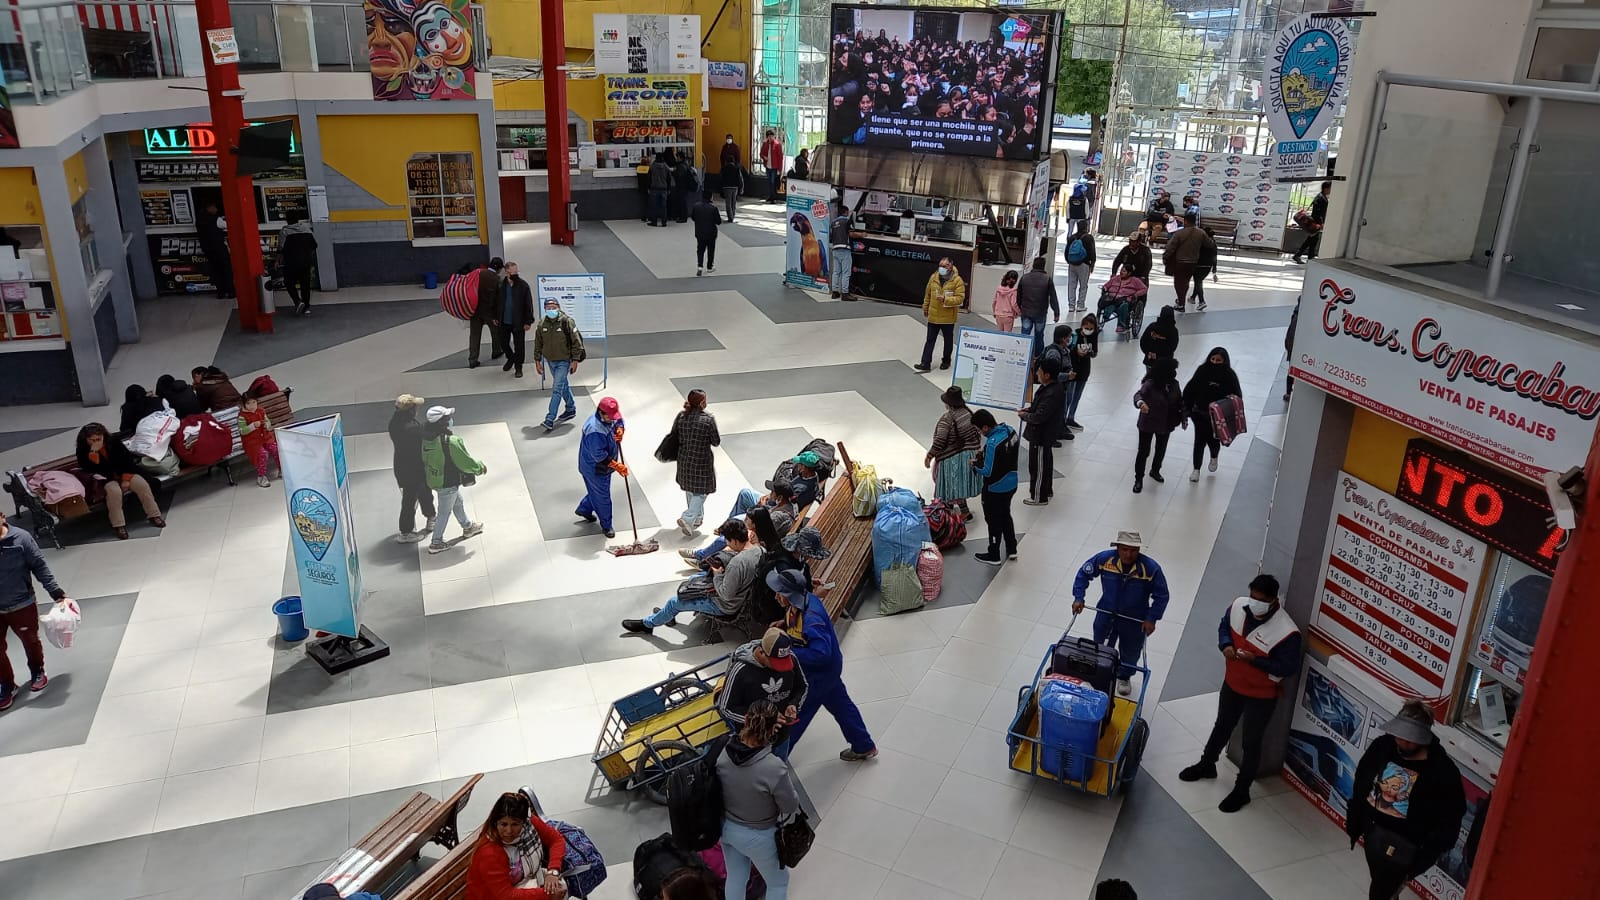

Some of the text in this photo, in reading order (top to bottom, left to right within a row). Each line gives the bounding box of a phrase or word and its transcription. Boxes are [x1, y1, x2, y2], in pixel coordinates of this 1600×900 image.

[1289, 23, 1301, 34] TU
[607, 77, 649, 90] TRANS.
[1338, 66, 1349, 78] DE
[607, 90, 689, 101] AROMA
[1269, 66, 1284, 114] SOLICITA
[1325, 79, 1345, 112] VIAJE
[612, 126, 675, 138] AROMA
[869, 127, 904, 137] aguante,
[906, 129, 921, 139] que
[934, 131, 945, 139] se
[947, 132, 974, 142] rompa
[871, 115, 993, 133] tiene que ser una mochila que
[911, 140, 945, 151] primera.
[1282, 141, 1315, 153] DESTINOS
[1279, 153, 1314, 167] SEGUROS
[884, 248, 932, 262] BOLETERÍA
[963, 342, 987, 352] TARIFAS
[1319, 279, 1600, 422] Trans. Copacaba
[1323, 362, 1368, 388] 72233555
[1419, 379, 1557, 443] VENTA DE PASAJES
[1414, 419, 1428, 431] ALTO
[1431, 426, 1449, 440] SANTA
[1499, 455, 1521, 469] ORURO
[1428, 414, 1536, 464] www.transcopacabanasa.com
[1377, 498, 1450, 550] Copacabana
[1353, 511, 1455, 570] VENTA DE PASAJES
[1369, 531, 1430, 572] COCHABAMBA
[307, 569, 336, 582] SEGUROS
[1344, 530, 1455, 599] 7:30 10:00 11:30 13:30
[1354, 547, 1438, 601] 16:00 20:30 21:30
[1337, 548, 1453, 620] 22:00 22:30 23:00 23:30
[1364, 575, 1417, 613] SANTA CRUZ
[1329, 569, 1450, 648] 14:00 16:30 17:30 19:00
[1341, 590, 1367, 611] SUCRE
[1326, 593, 1443, 674] 18:30 19:30 20:30 21:00
[1364, 631, 1392, 656] TARIJA
[1363, 645, 1388, 666] 18:30
